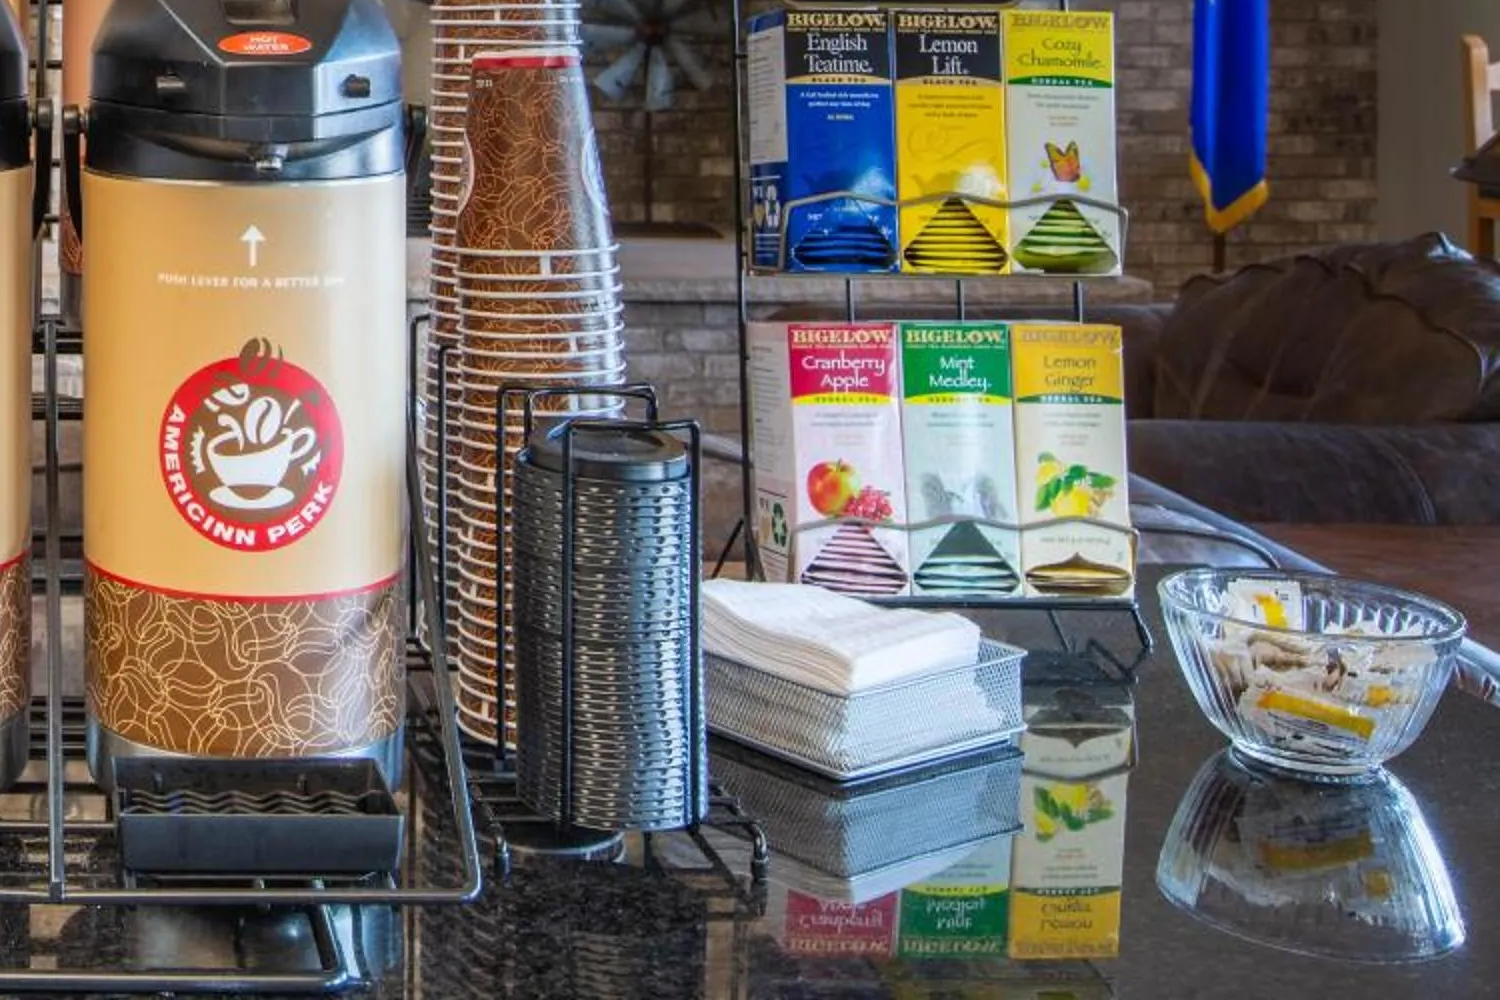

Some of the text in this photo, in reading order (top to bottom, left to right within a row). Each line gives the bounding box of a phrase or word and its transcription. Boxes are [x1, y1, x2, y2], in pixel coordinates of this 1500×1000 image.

[787, 13, 886, 27] BIGELOW
[897, 13, 998, 29] BIGELOW
[806, 32, 868, 55] English
[919, 33, 978, 53] Lemon
[1041, 38, 1082, 56] Cozy
[804, 53, 871, 73] Teatime
[932, 55, 964, 75] Lift
[1016, 48, 1102, 68] Chamomile
[191, 275, 229, 287] LEVER
[233, 277, 257, 288] FOR
[261, 277, 271, 288] A
[274, 276, 318, 288] BETTER
[790, 329, 892, 344] BIGELOW
[906, 329, 1004, 345] BIGELOW
[801, 350, 885, 376] Cranberry
[940, 354, 975, 370] Mint
[1043, 355, 1097, 370] Lemon
[820, 368, 869, 394] Apple
[929, 366, 988, 393] Medley
[1045, 373, 1095, 392] Ginger
[163, 403, 334, 546] AMERICINN PERK
